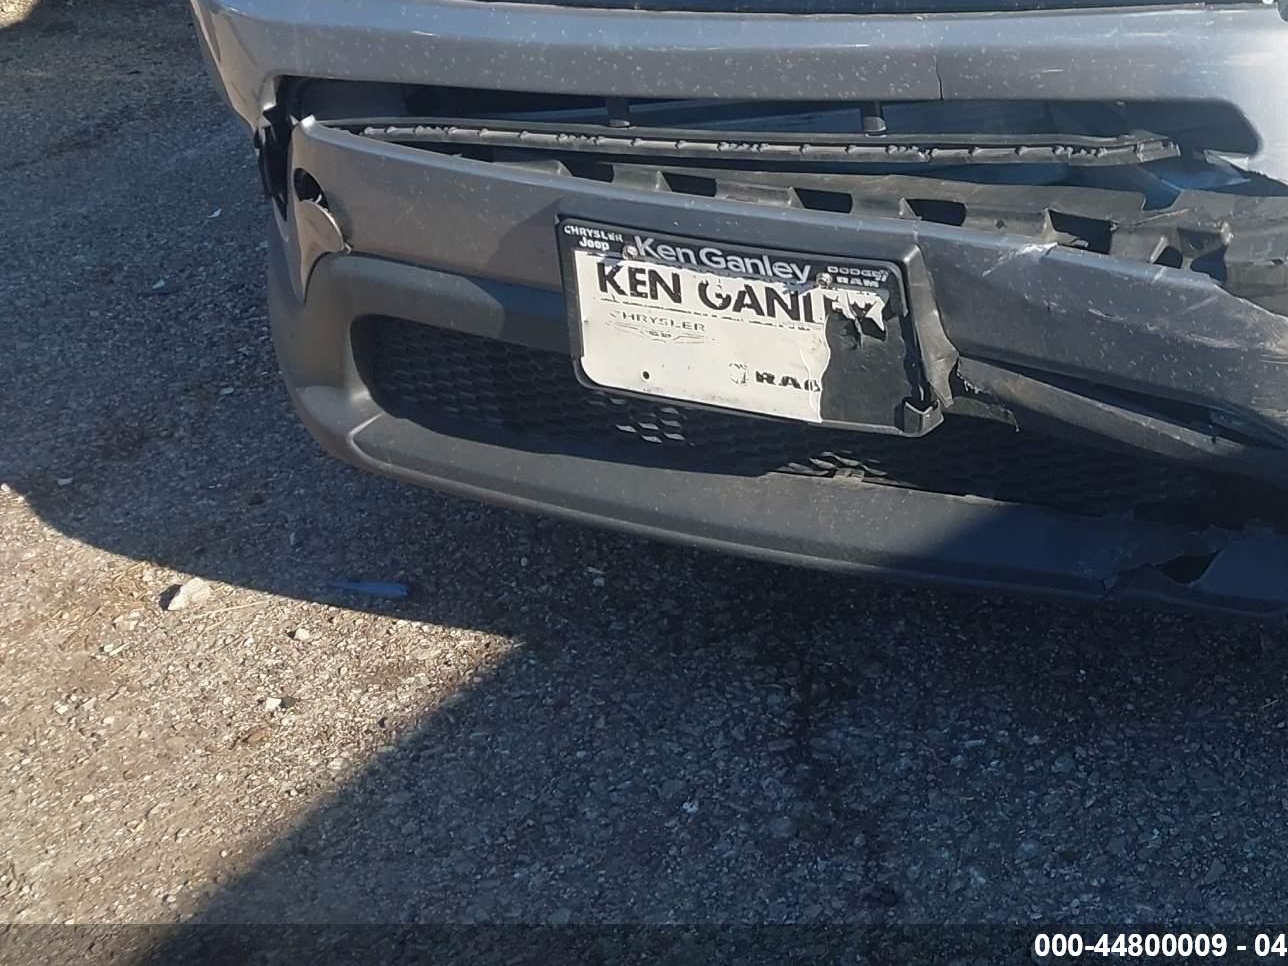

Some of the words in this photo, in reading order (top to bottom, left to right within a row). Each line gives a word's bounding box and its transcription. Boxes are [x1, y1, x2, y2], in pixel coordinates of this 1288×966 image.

[563, 225, 624, 243] CHRYSLER
[579, 237, 610, 252] Jeep
[633, 235, 698, 268] Ken
[701, 247, 811, 285] Ganley
[827, 265, 883, 278] DODGE
[596, 262, 682, 305] KEN
[836, 276, 880, 289] RAM
